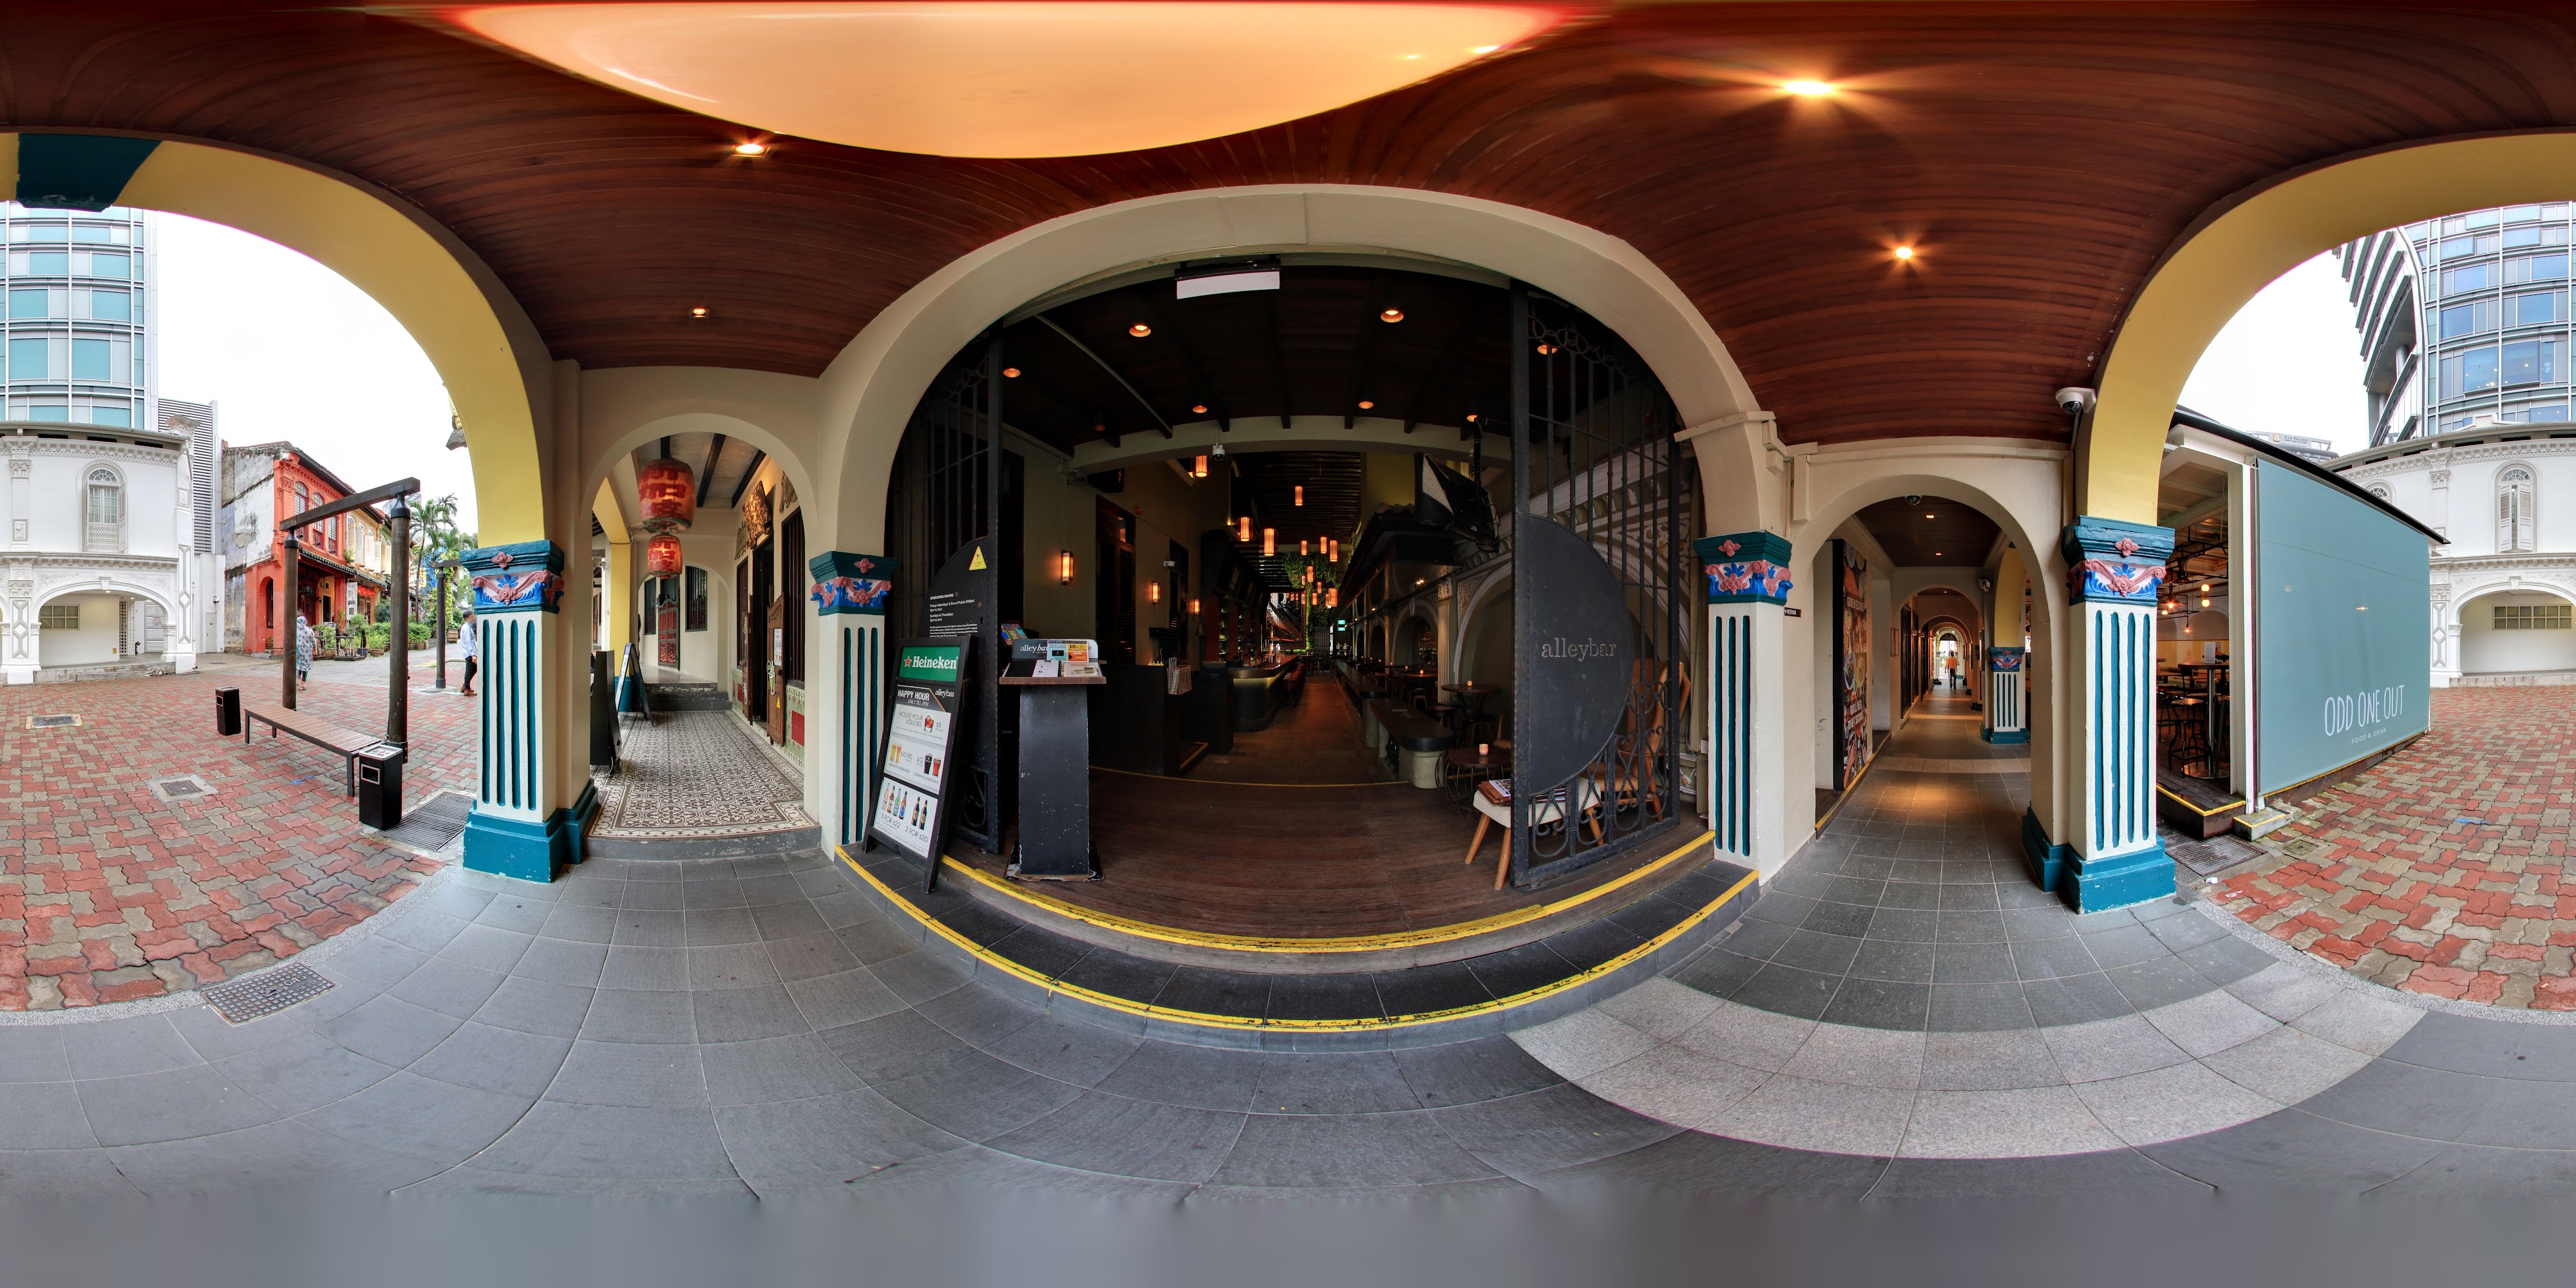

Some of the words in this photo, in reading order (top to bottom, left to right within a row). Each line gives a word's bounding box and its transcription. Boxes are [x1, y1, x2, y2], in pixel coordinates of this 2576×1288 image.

[1542, 638, 1616, 661] alleybar
[912, 656, 957, 669] Heineken
[897, 689, 914, 699] HAPPY
[914, 692, 929, 701] HOUR
[2324, 695, 2354, 736] ODD
[2358, 690, 2380, 727] ONE
[2383, 685, 2405, 719] OUT
[905, 719, 922, 727] LIQUORS
[2351, 734, 2366, 744] FOOD
[2373, 728, 2387, 737] DRINK
[900, 751, 913, 759] $10.90
[884, 815, 893, 824] FOR
[909, 828, 918, 838] FOR
[283, 974, 307, 987] GAS
[294, 980, 317, 992] 1979
